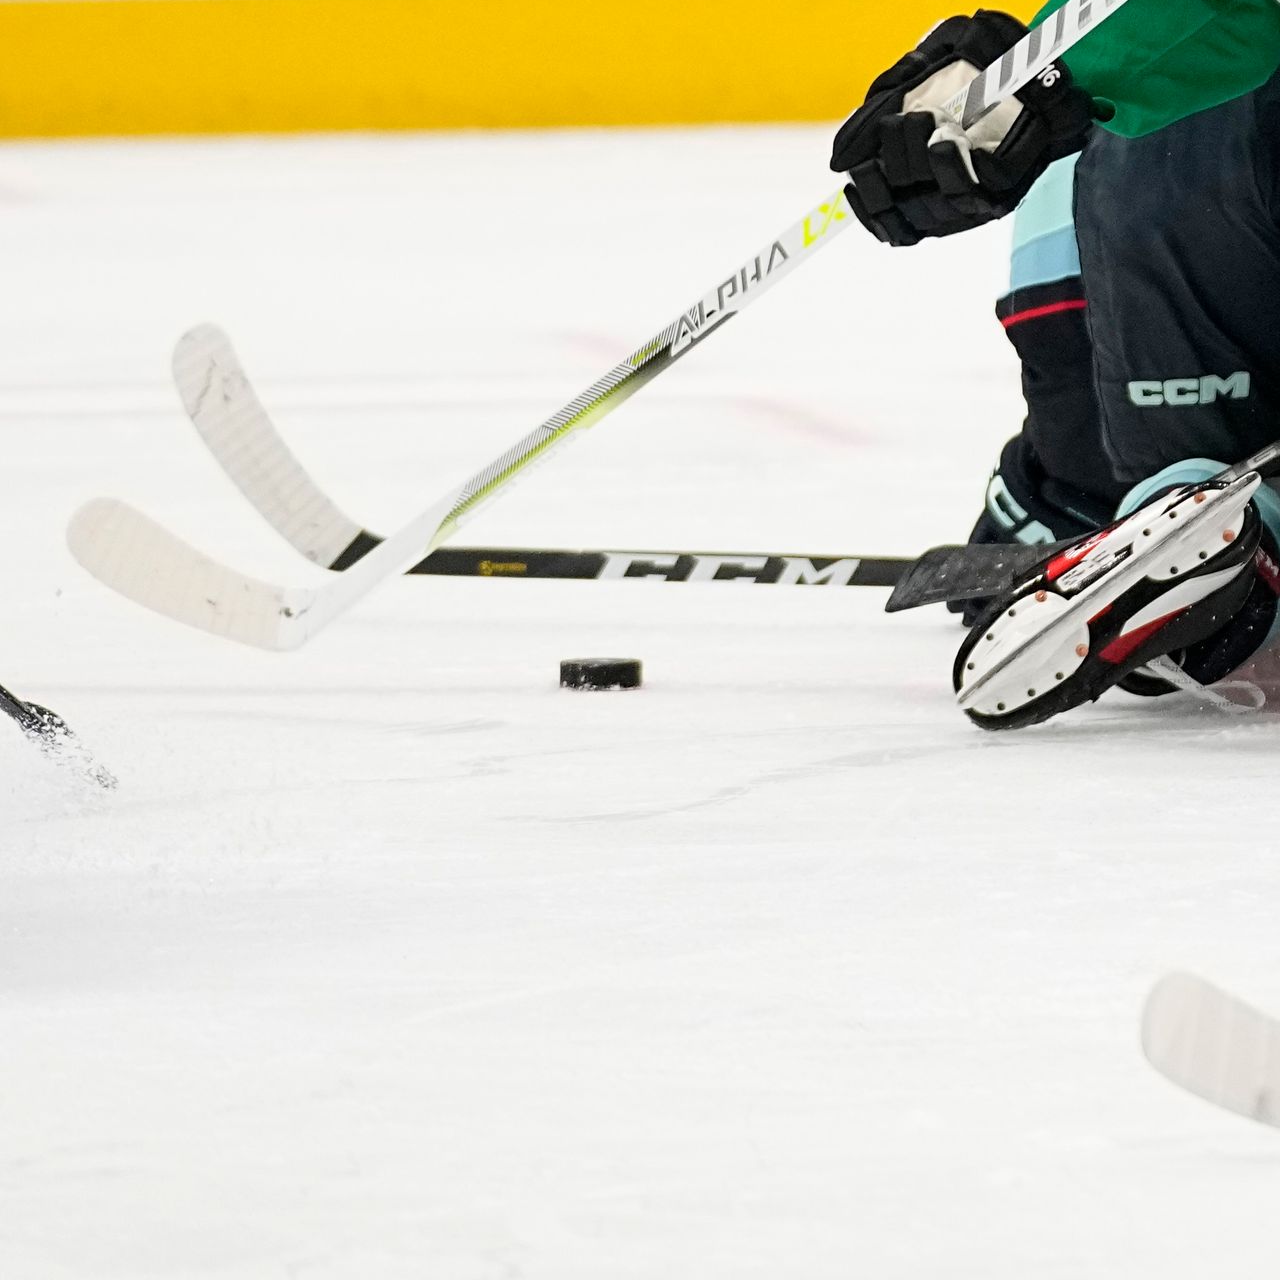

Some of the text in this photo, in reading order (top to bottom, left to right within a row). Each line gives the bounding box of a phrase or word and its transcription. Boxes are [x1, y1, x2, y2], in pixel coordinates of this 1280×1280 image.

[670, 240, 789, 356] ALPHA
[1128, 370, 1251, 407] CCM
[599, 551, 860, 587] CCM
